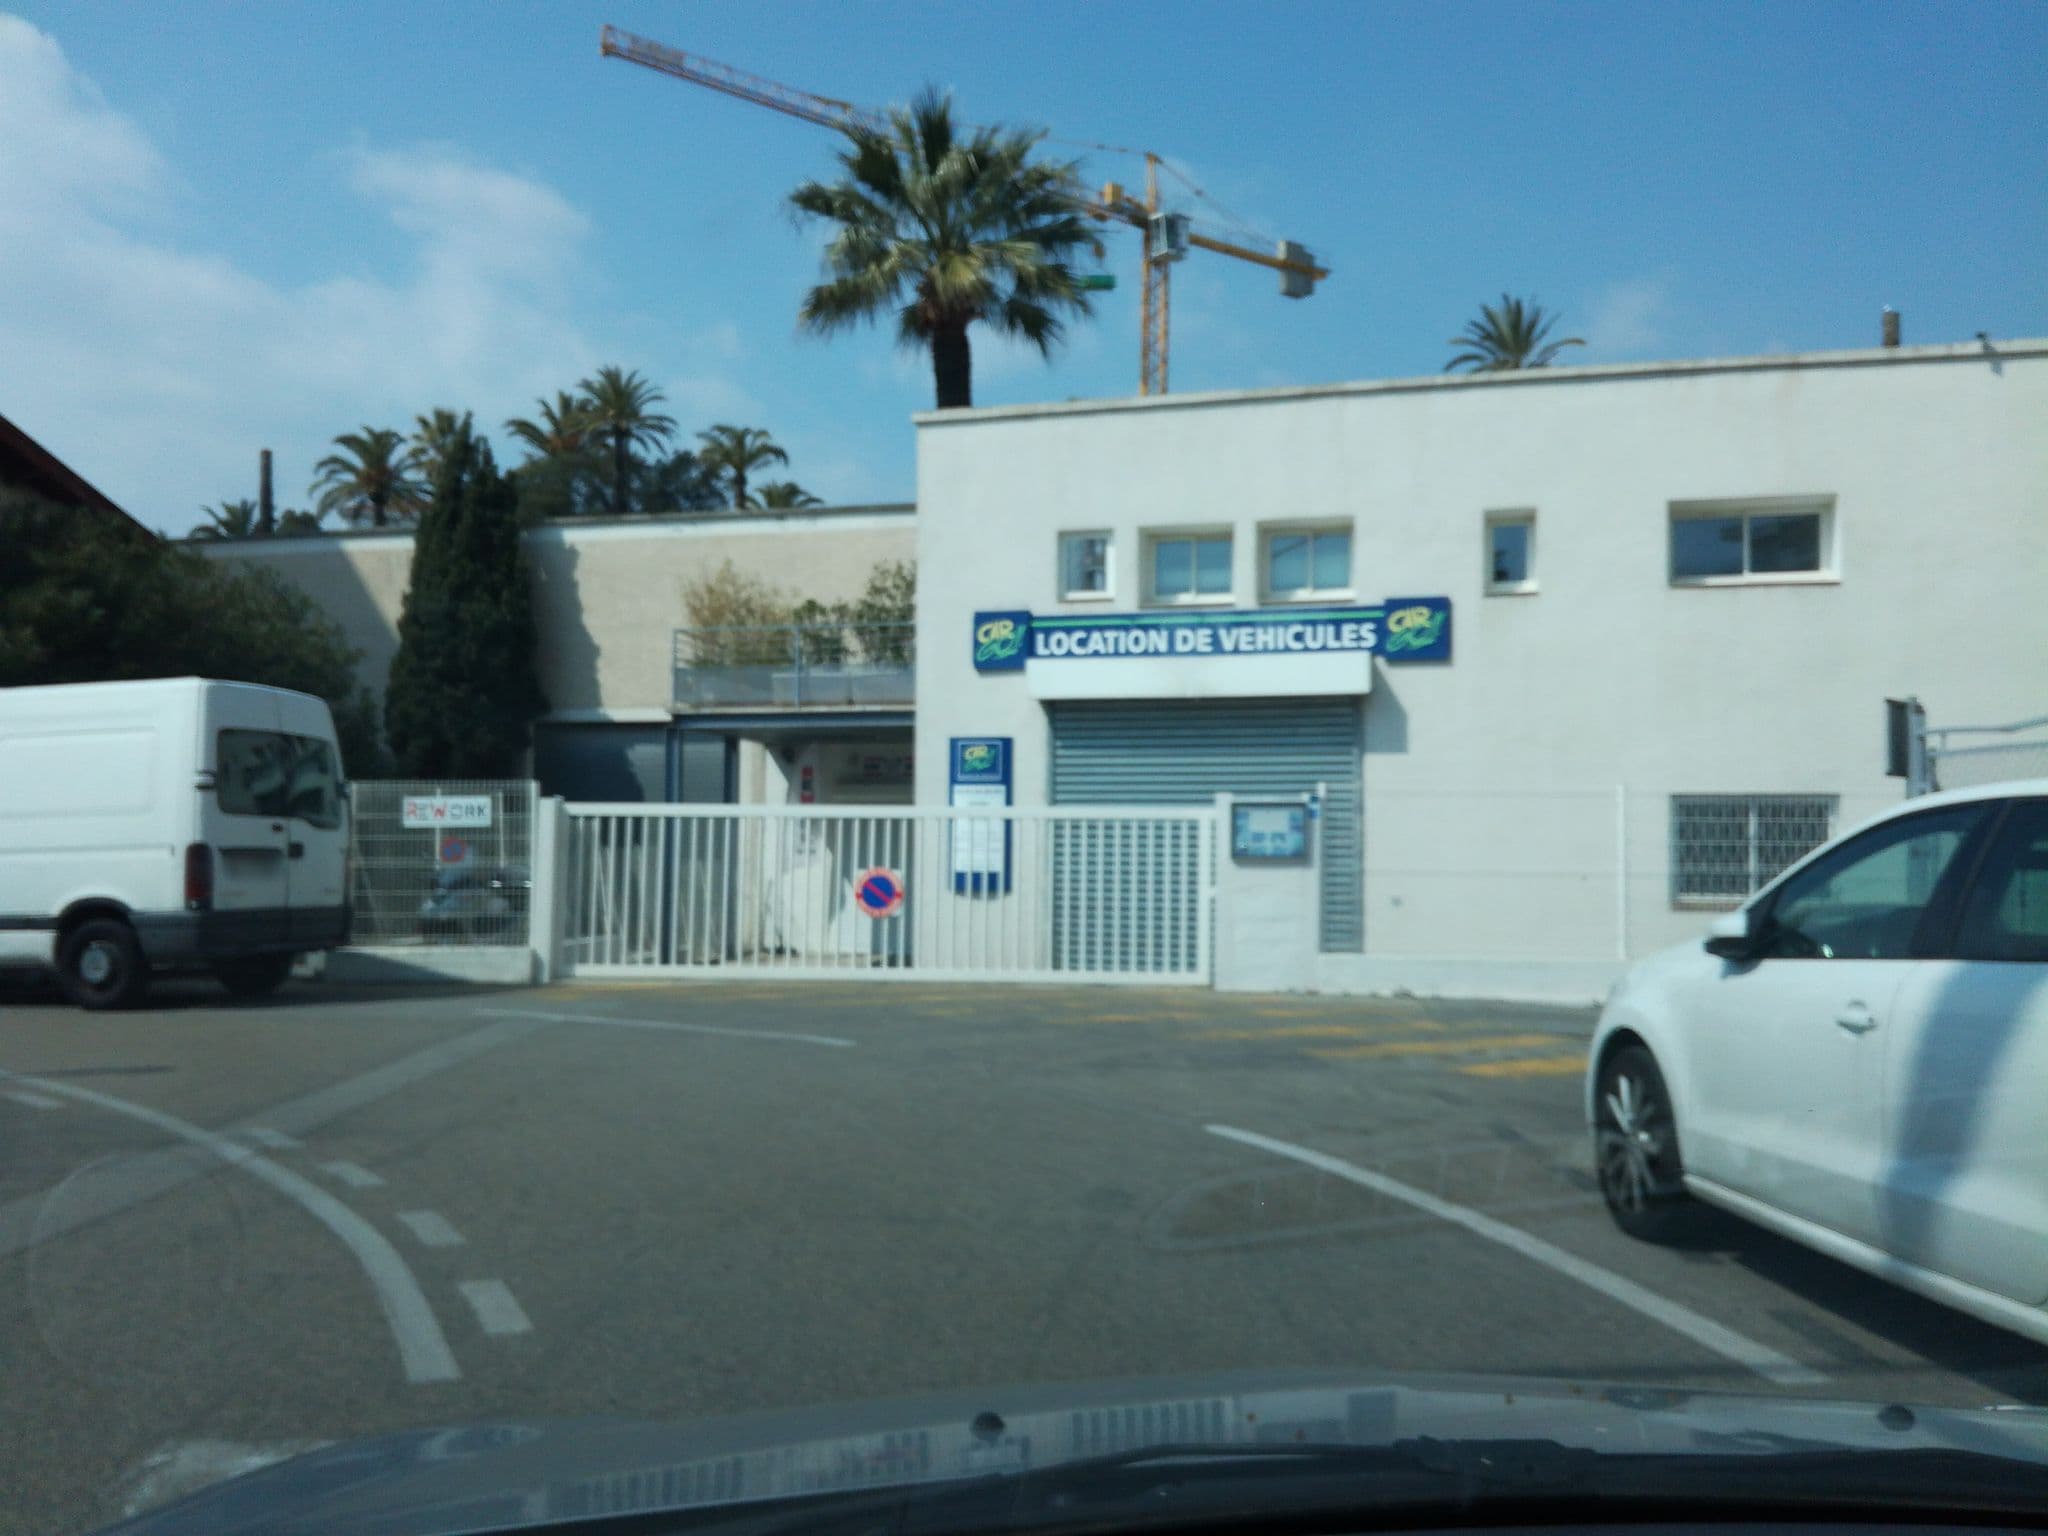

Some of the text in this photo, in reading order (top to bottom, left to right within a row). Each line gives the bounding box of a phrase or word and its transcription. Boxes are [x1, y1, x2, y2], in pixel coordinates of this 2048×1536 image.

[1035, 623, 1378, 656] LOCATION DE VEHICULES
